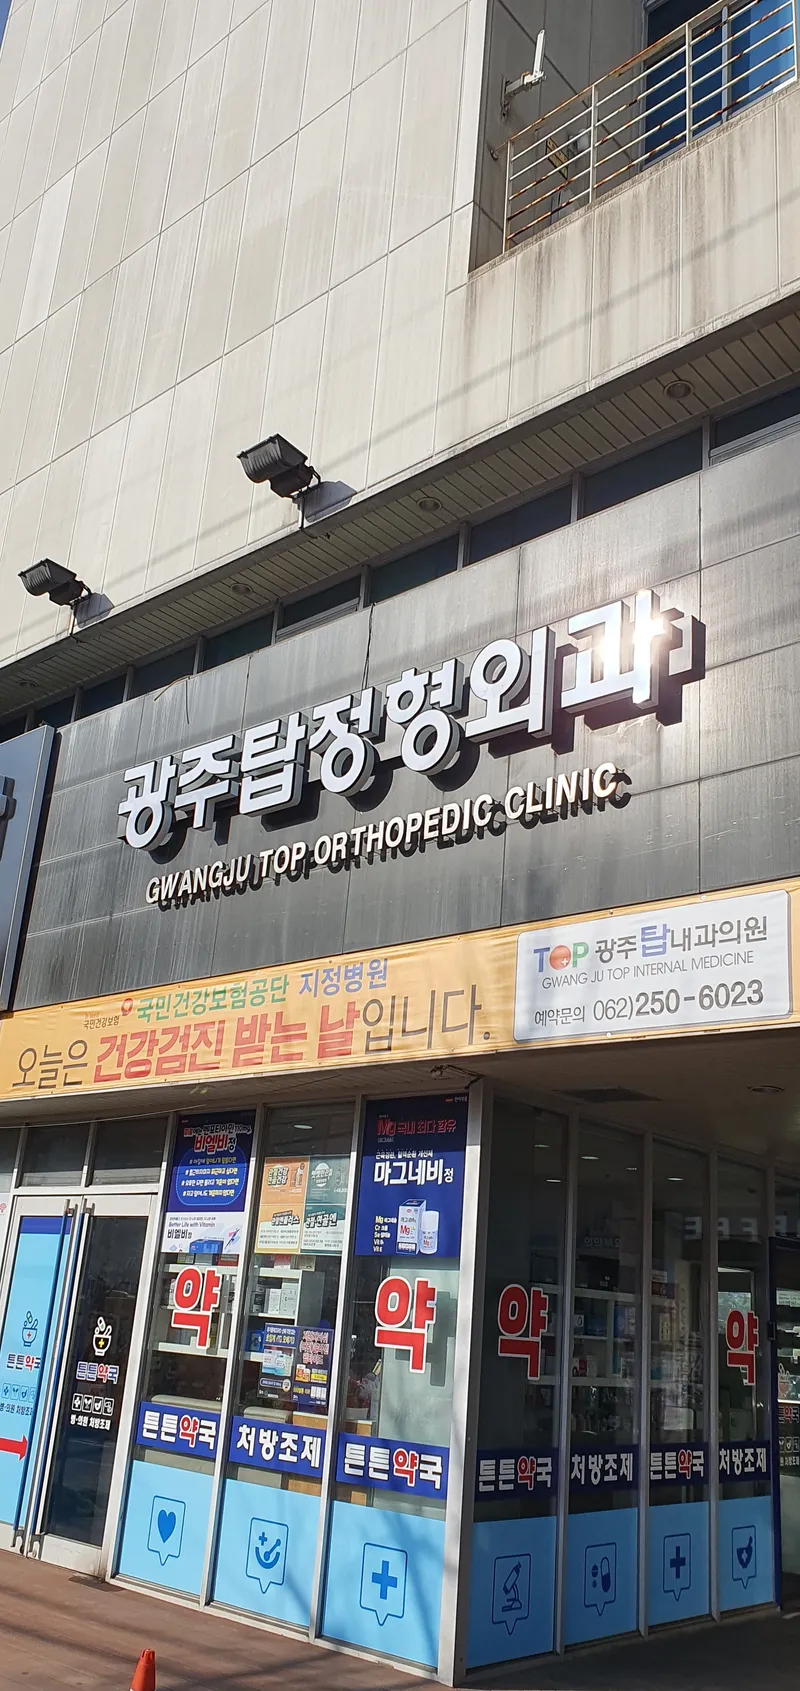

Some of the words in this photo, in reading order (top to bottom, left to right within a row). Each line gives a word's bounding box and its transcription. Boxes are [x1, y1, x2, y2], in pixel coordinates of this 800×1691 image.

[118, 588, 696, 852] 광주탑정형외과
[145, 857, 251, 905] GWANGJU
[258, 841, 306, 877] TOP
[312, 793, 494, 866] ORTHOPEDIC
[504, 761, 619, 822] CLINIC
[534, 941, 589, 973] TOP
[595, 915, 767, 964] 광주탑내과의원
[137, 974, 289, 1023] 국민건강보험공단
[299, 957, 389, 998] 지정병원
[542, 970, 588, 990] GWANG
[590, 969, 604, 984] JU
[607, 966, 630, 981] TOP
[633, 958, 688, 978] INTERNAL
[691, 950, 754, 971] MEDICINE
[84, 1015, 120, 1030] 국민건강보험
[534, 1005, 585, 1027] 예약문의
[593, 979, 764, 1022] 062)250-6023
[12, 1038, 88, 1089] 오늘은
[94, 1019, 227, 1084] 건강검진
[232, 1010, 308, 1068] 받는
[317, 985, 491, 1060] 날입니다.
[374, 1158, 454, 1186] 마그네비정
[171, 1266, 222, 1350] 약
[374, 1276, 438, 1374] 약
[497, 1283, 549, 1381] 약
[725, 1308, 759, 1386] 약
[76, 1361, 119, 1384] 튼튼약국
[89, 1418, 111, 1430] 처방조제
[142, 1410, 217, 1450] 튼튼약국
[236, 1424, 322, 1468] 처방조제
[343, 1441, 442, 1490] 튼튼약국
[478, 1455, 552, 1492] 튼튼약국
[570, 1452, 633, 1485] 처방조제
[650, 1449, 705, 1480] 튼튼약국
[718, 1447, 767, 1476] 처방조제
